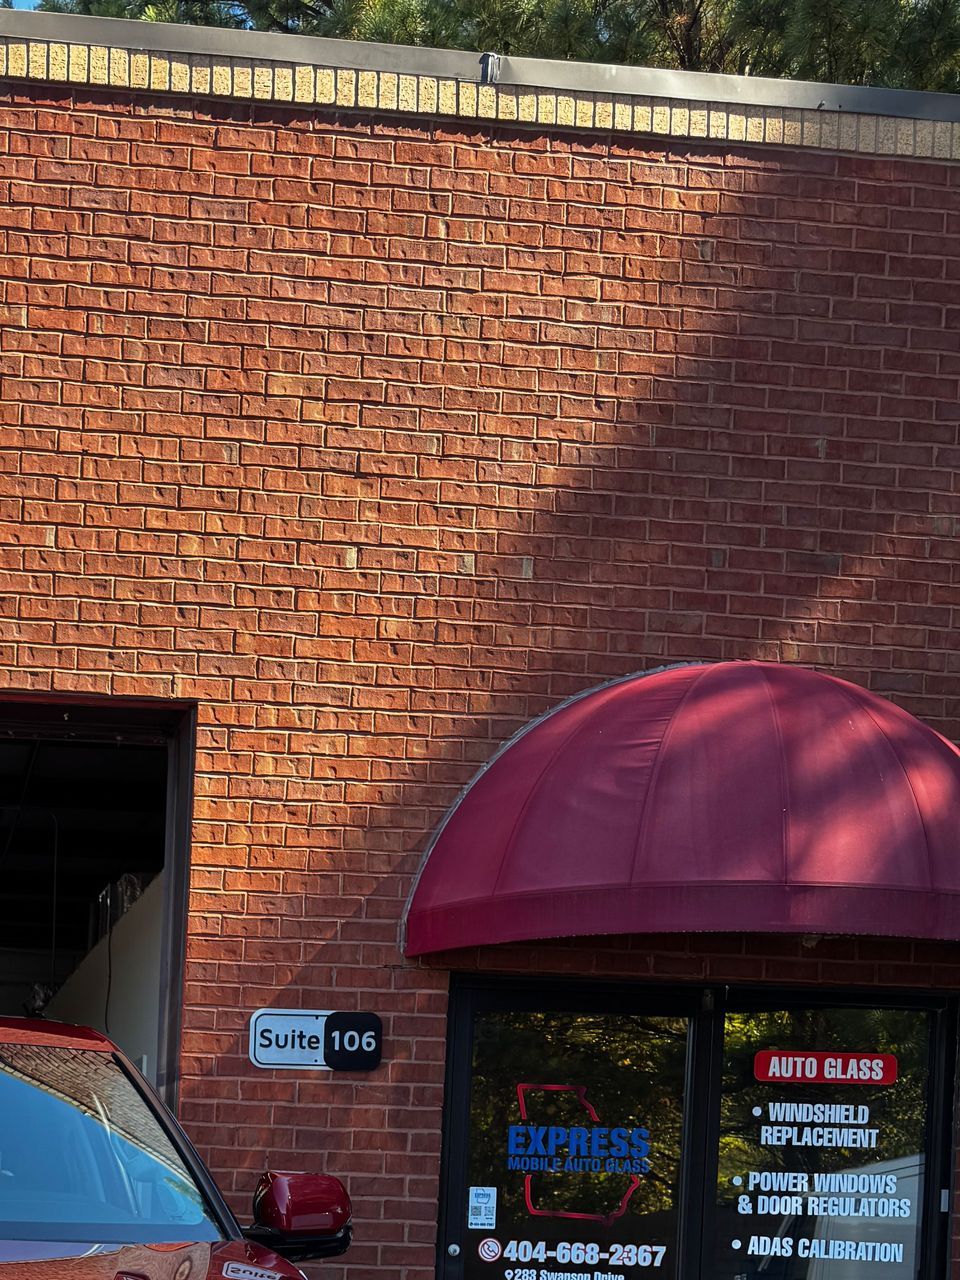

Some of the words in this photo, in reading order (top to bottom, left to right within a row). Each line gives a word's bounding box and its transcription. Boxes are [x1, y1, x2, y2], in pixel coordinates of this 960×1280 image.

[259, 1028, 321, 1050] Suite
[331, 1030, 377, 1052] 106
[768, 1056, 817, 1078] AUTO
[824, 1058, 884, 1080] GLASS
[768, 1102, 869, 1124] WINDSHIELD
[507, 1125, 651, 1157] EXPRESS
[760, 1126, 879, 1148] REPLACEMENT
[508, 1157, 561, 1171] MOBILE
[564, 1158, 601, 1172] AUTO
[605, 1159, 651, 1173] GLASS
[748, 1172, 809, 1192] POWER
[814, 1173, 897, 1194] WINDOWS
[737, 1195, 753, 1214] &
[757, 1196, 803, 1216] DOOR
[807, 1197, 911, 1217] REGULATORS
[503, 1240, 667, 1267] 404-668-2367
[747, 1236, 793, 1257] ADAS
[798, 1238, 904, 1262] CALIBRATION
